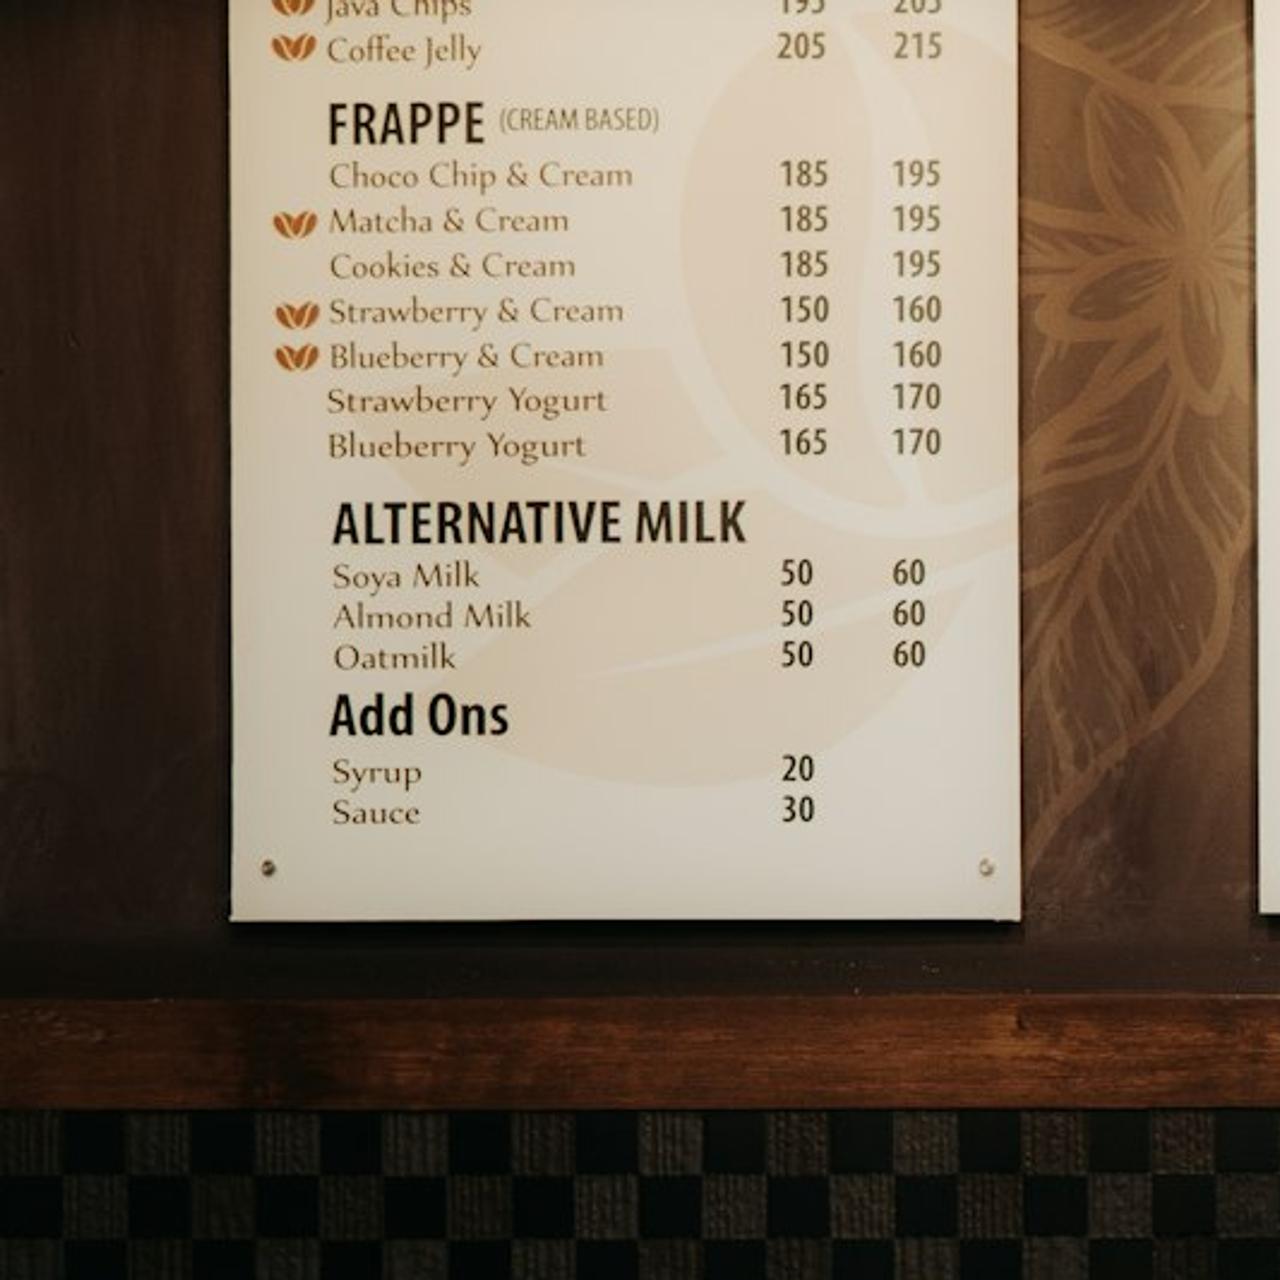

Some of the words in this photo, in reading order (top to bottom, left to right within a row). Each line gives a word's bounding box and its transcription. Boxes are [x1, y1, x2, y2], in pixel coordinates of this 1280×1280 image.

[327, 34, 416, 63] Coffee
[425, 33, 481, 70] Jelly
[777, 32, 825, 59] 205
[894, 31, 942, 59] 215
[330, 102, 484, 145] FRAPPE
[500, 108, 579, 134] (CREAM
[585, 107, 659, 133] BASED)
[329, 161, 419, 188] Choco
[429, 159, 496, 196] Chip
[507, 162, 528, 187] &
[539, 161, 632, 187] Cream
[781, 160, 827, 187] 185
[893, 160, 940, 187] 195
[330, 205, 432, 233] Matcha
[443, 208, 464, 232] &
[475, 207, 568, 233] Cream
[781, 205, 827, 232] 185
[894, 204, 940, 232] 195
[330, 250, 439, 279] Cookies
[449, 253, 470, 277] &
[482, 252, 575, 278] Cream
[781, 250, 828, 277] 185
[894, 250, 940, 277] 195
[329, 295, 488, 332] Strawberry
[497, 298, 519, 323] &
[530, 298, 623, 323] Cream
[781, 295, 829, 323] 150
[893, 295, 942, 323] 160
[331, 341, 467, 377] Blueberry
[477, 343, 498, 368] &
[510, 343, 603, 368] Cream
[781, 341, 829, 368] 150
[894, 341, 942, 368] 160
[328, 385, 497, 421] Strawberry
[509, 387, 606, 421] Yogurt
[780, 383, 827, 410] 165
[893, 382, 941, 410] 170
[329, 430, 476, 466] Blueberry
[487, 432, 585, 466] Yogurt
[780, 428, 827, 455] 165
[893, 428, 941, 455] 170
[333, 501, 621, 545] ALTERNATIVE
[636, 500, 745, 543] MILK
[334, 564, 401, 597] Soya
[413, 560, 479, 587] Milk
[782, 559, 813, 586] 50
[893, 559, 925, 586] 60
[334, 601, 452, 629] Almond
[465, 600, 531, 628] Milk
[782, 600, 813, 627] 50
[893, 600, 925, 627] 60
[334, 641, 455, 670] Oatmilk
[782, 641, 813, 667] 50
[893, 640, 925, 667] 60
[330, 692, 413, 736] Add
[428, 693, 508, 736] Ons
[333, 759, 421, 792] Syrup
[782, 754, 814, 781] 20
[333, 800, 419, 824] Sauce
[783, 795, 814, 822] 30
